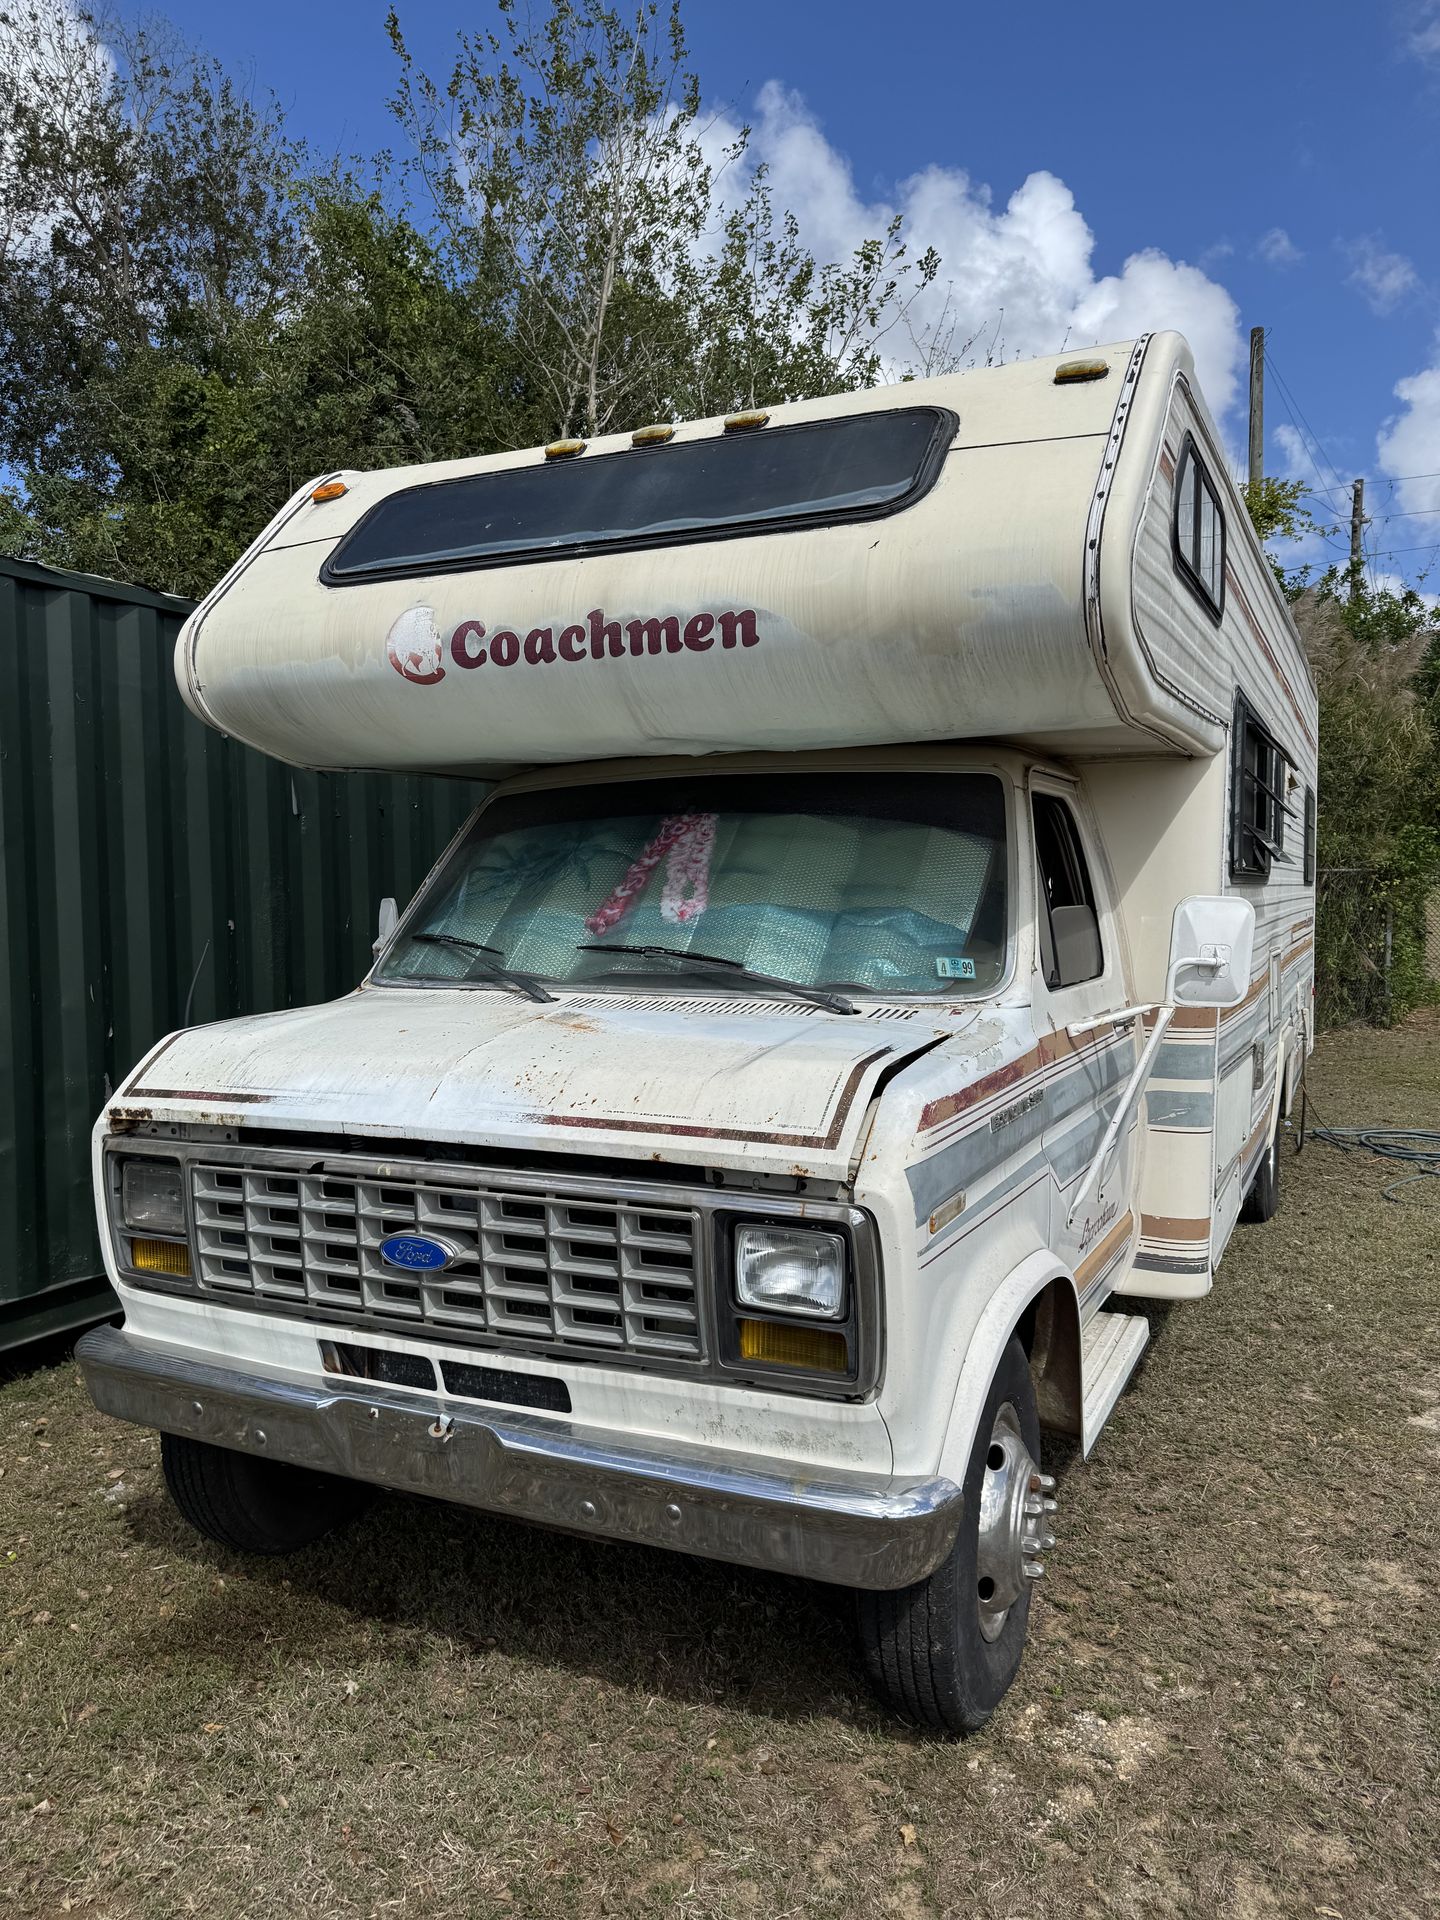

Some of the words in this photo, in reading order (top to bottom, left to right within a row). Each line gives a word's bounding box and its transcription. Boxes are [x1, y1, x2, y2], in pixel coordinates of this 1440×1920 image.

[450, 608, 761, 670] Coachmen
[962, 961, 973, 974] 99
[395, 1240, 434, 1264] Ford
